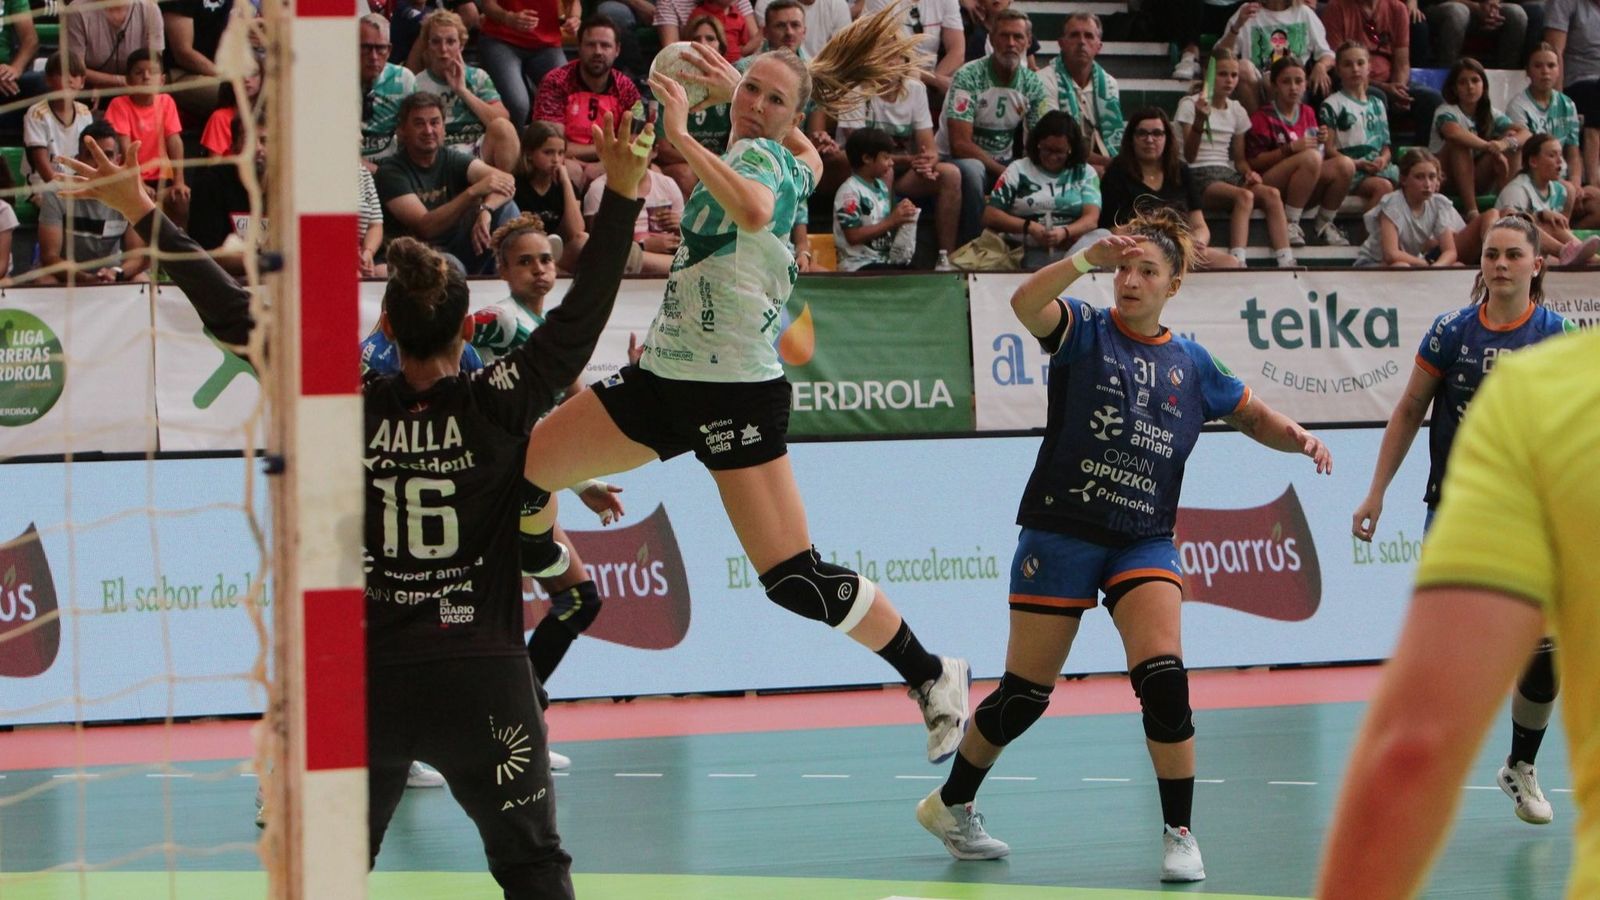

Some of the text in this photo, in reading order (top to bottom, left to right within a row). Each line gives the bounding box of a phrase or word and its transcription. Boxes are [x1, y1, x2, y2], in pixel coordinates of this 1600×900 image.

[588, 98, 599, 121] 5
[996, 96, 1007, 118] 5
[1240, 290, 1400, 350] teika
[12, 329, 45, 346] LIGA
[1133, 356, 1156, 388] 31
[1261, 360, 1399, 394] EL BUEN VENDING
[792, 379, 955, 411] ERDROLA
[369, 416, 463, 453] AALLA
[1130, 433, 1174, 459] amara
[1134, 419, 1174, 443] super
[1080, 458, 1157, 496] GIPUZKOA
[1104, 448, 1155, 476] ORAIN
[372, 476, 460, 560] 16
[886, 545, 1000, 584] excelencia
[101, 576, 127, 614] El
[135, 575, 202, 612] sabor
[211, 573, 238, 609] de
[440, 606, 475, 615] DIARIO
[440, 614, 474, 624] VASCO
[501, 787, 546, 811] AVID
